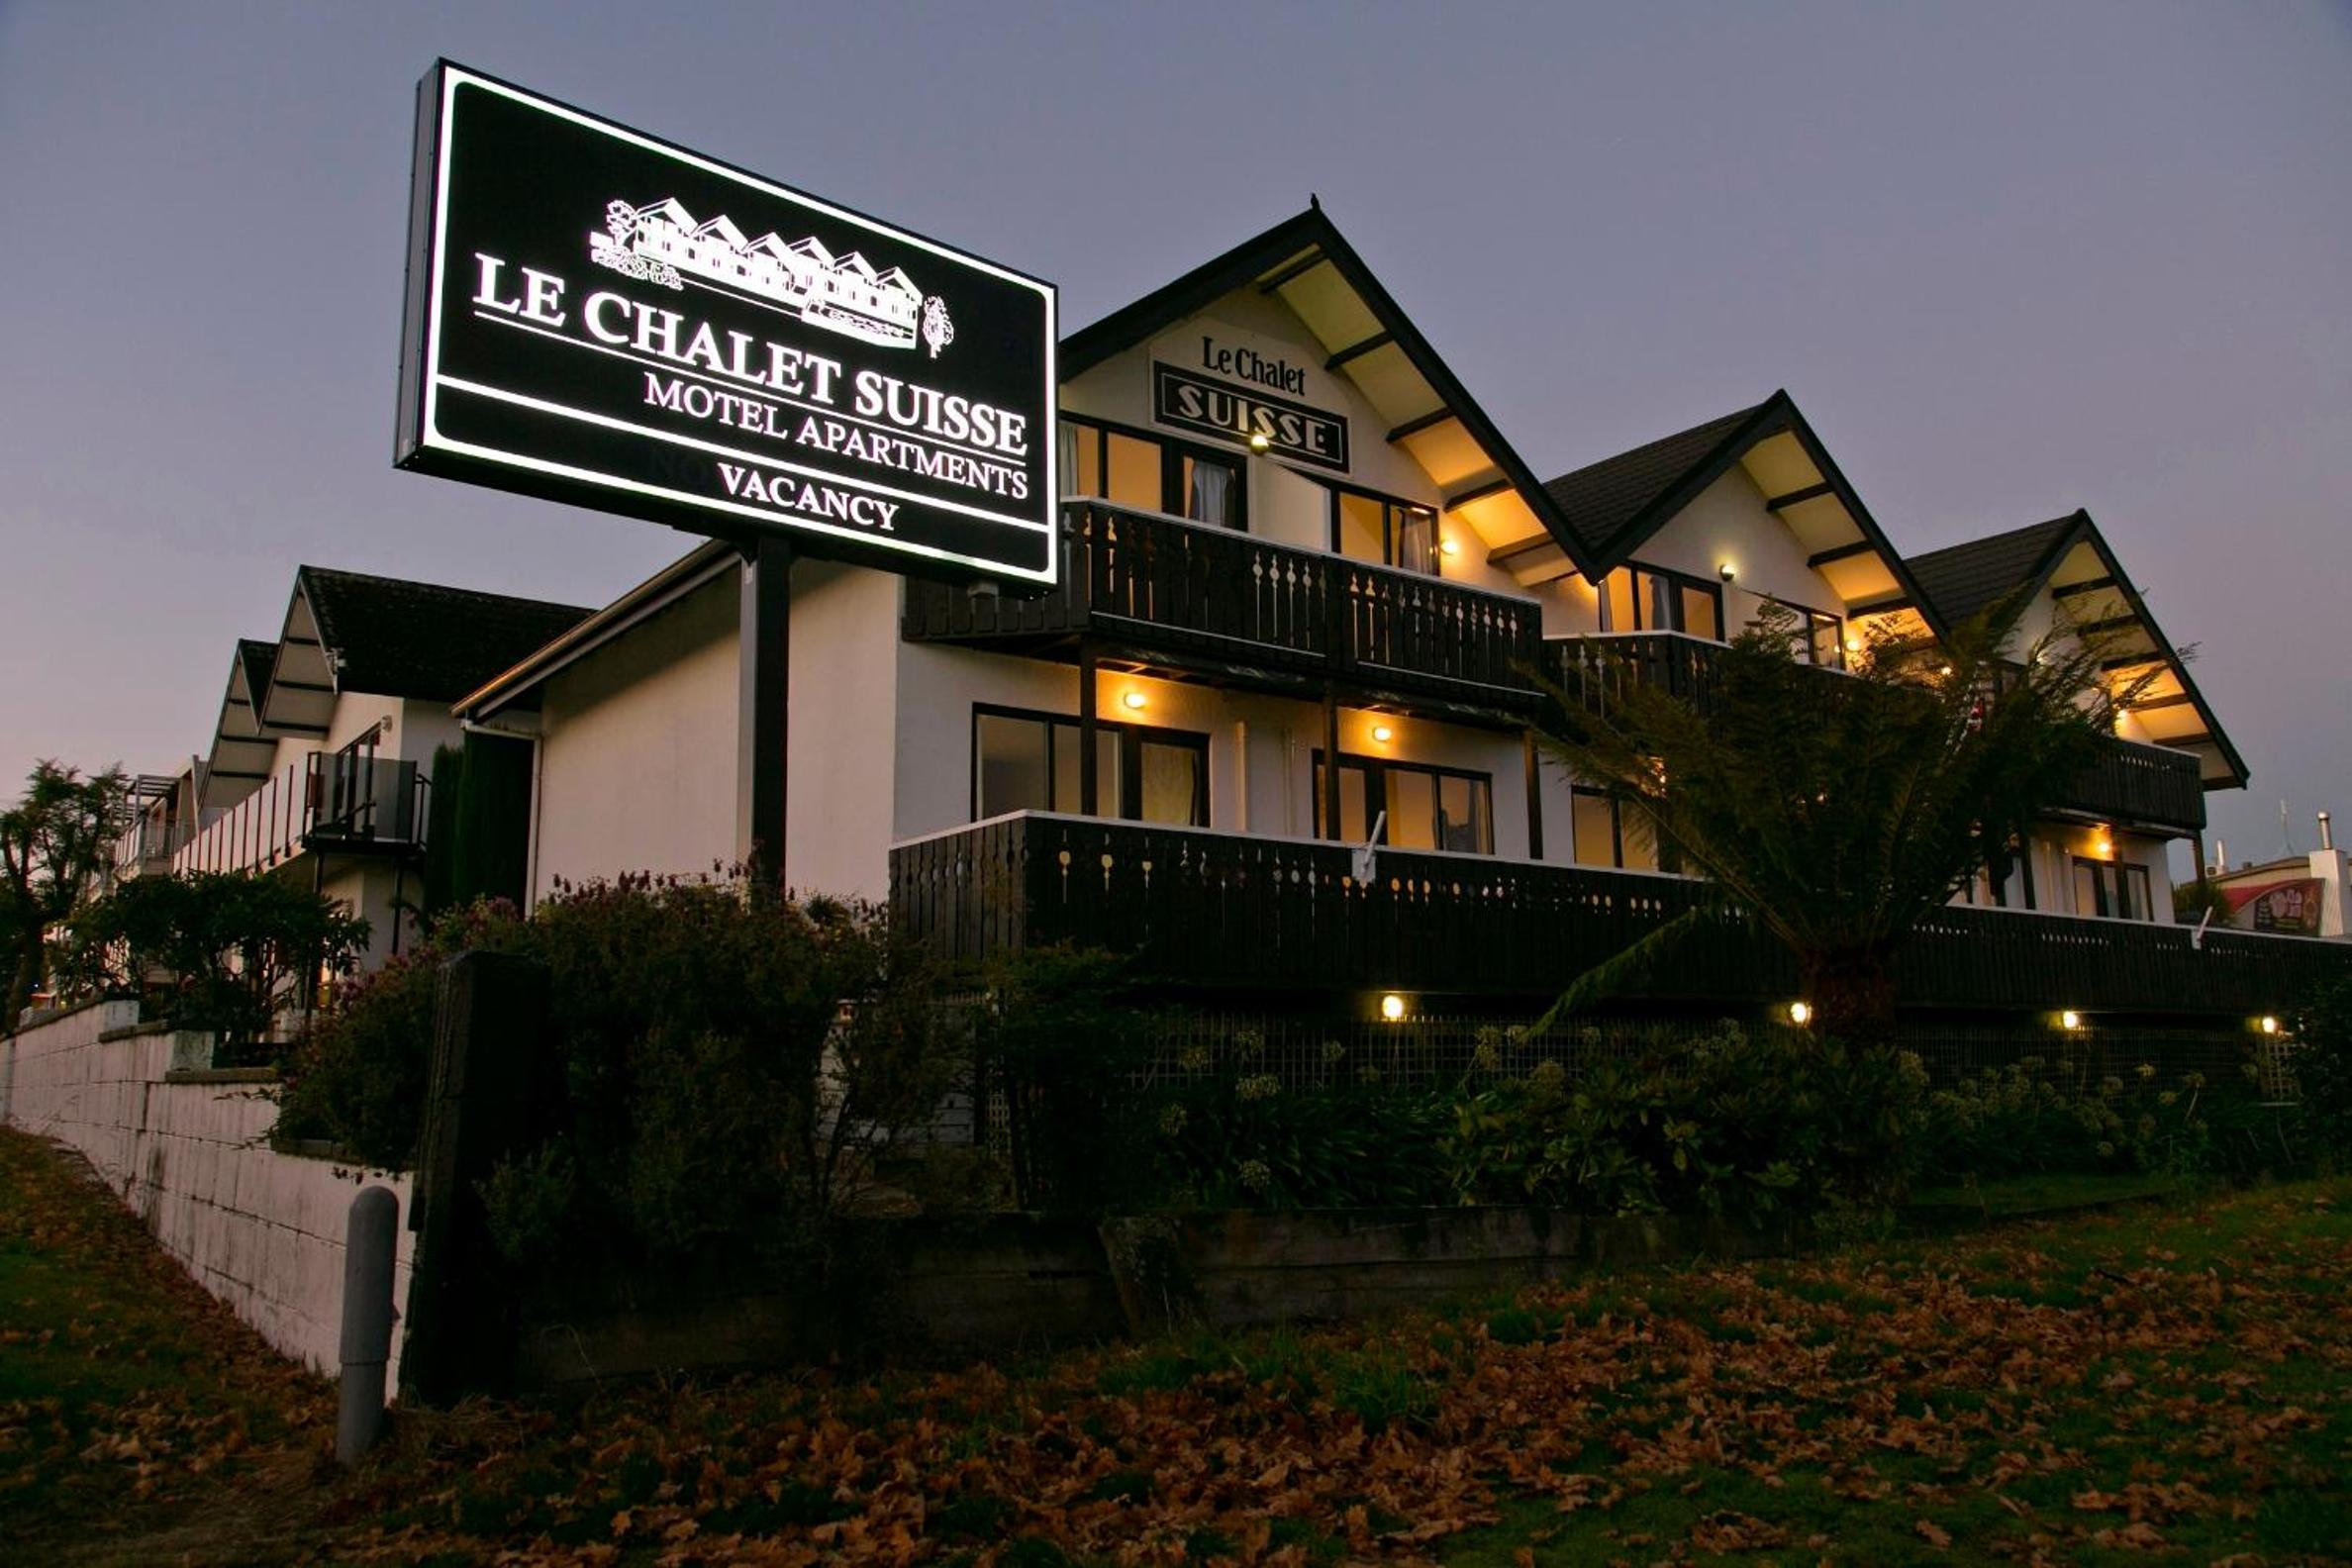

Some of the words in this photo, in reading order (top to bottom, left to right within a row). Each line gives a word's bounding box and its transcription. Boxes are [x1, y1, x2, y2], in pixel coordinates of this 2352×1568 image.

[472, 251, 567, 328] LE
[584, 291, 842, 405] CHALET
[854, 369, 1029, 457] SUISSE
[1202, 336, 1232, 374] Le
[1234, 347, 1306, 396] Chalet
[643, 371, 789, 441] MOTEL
[795, 416, 1029, 500] APARTMENTS
[1177, 384, 1328, 454] SUISSE
[717, 461, 900, 532] VACANCY
